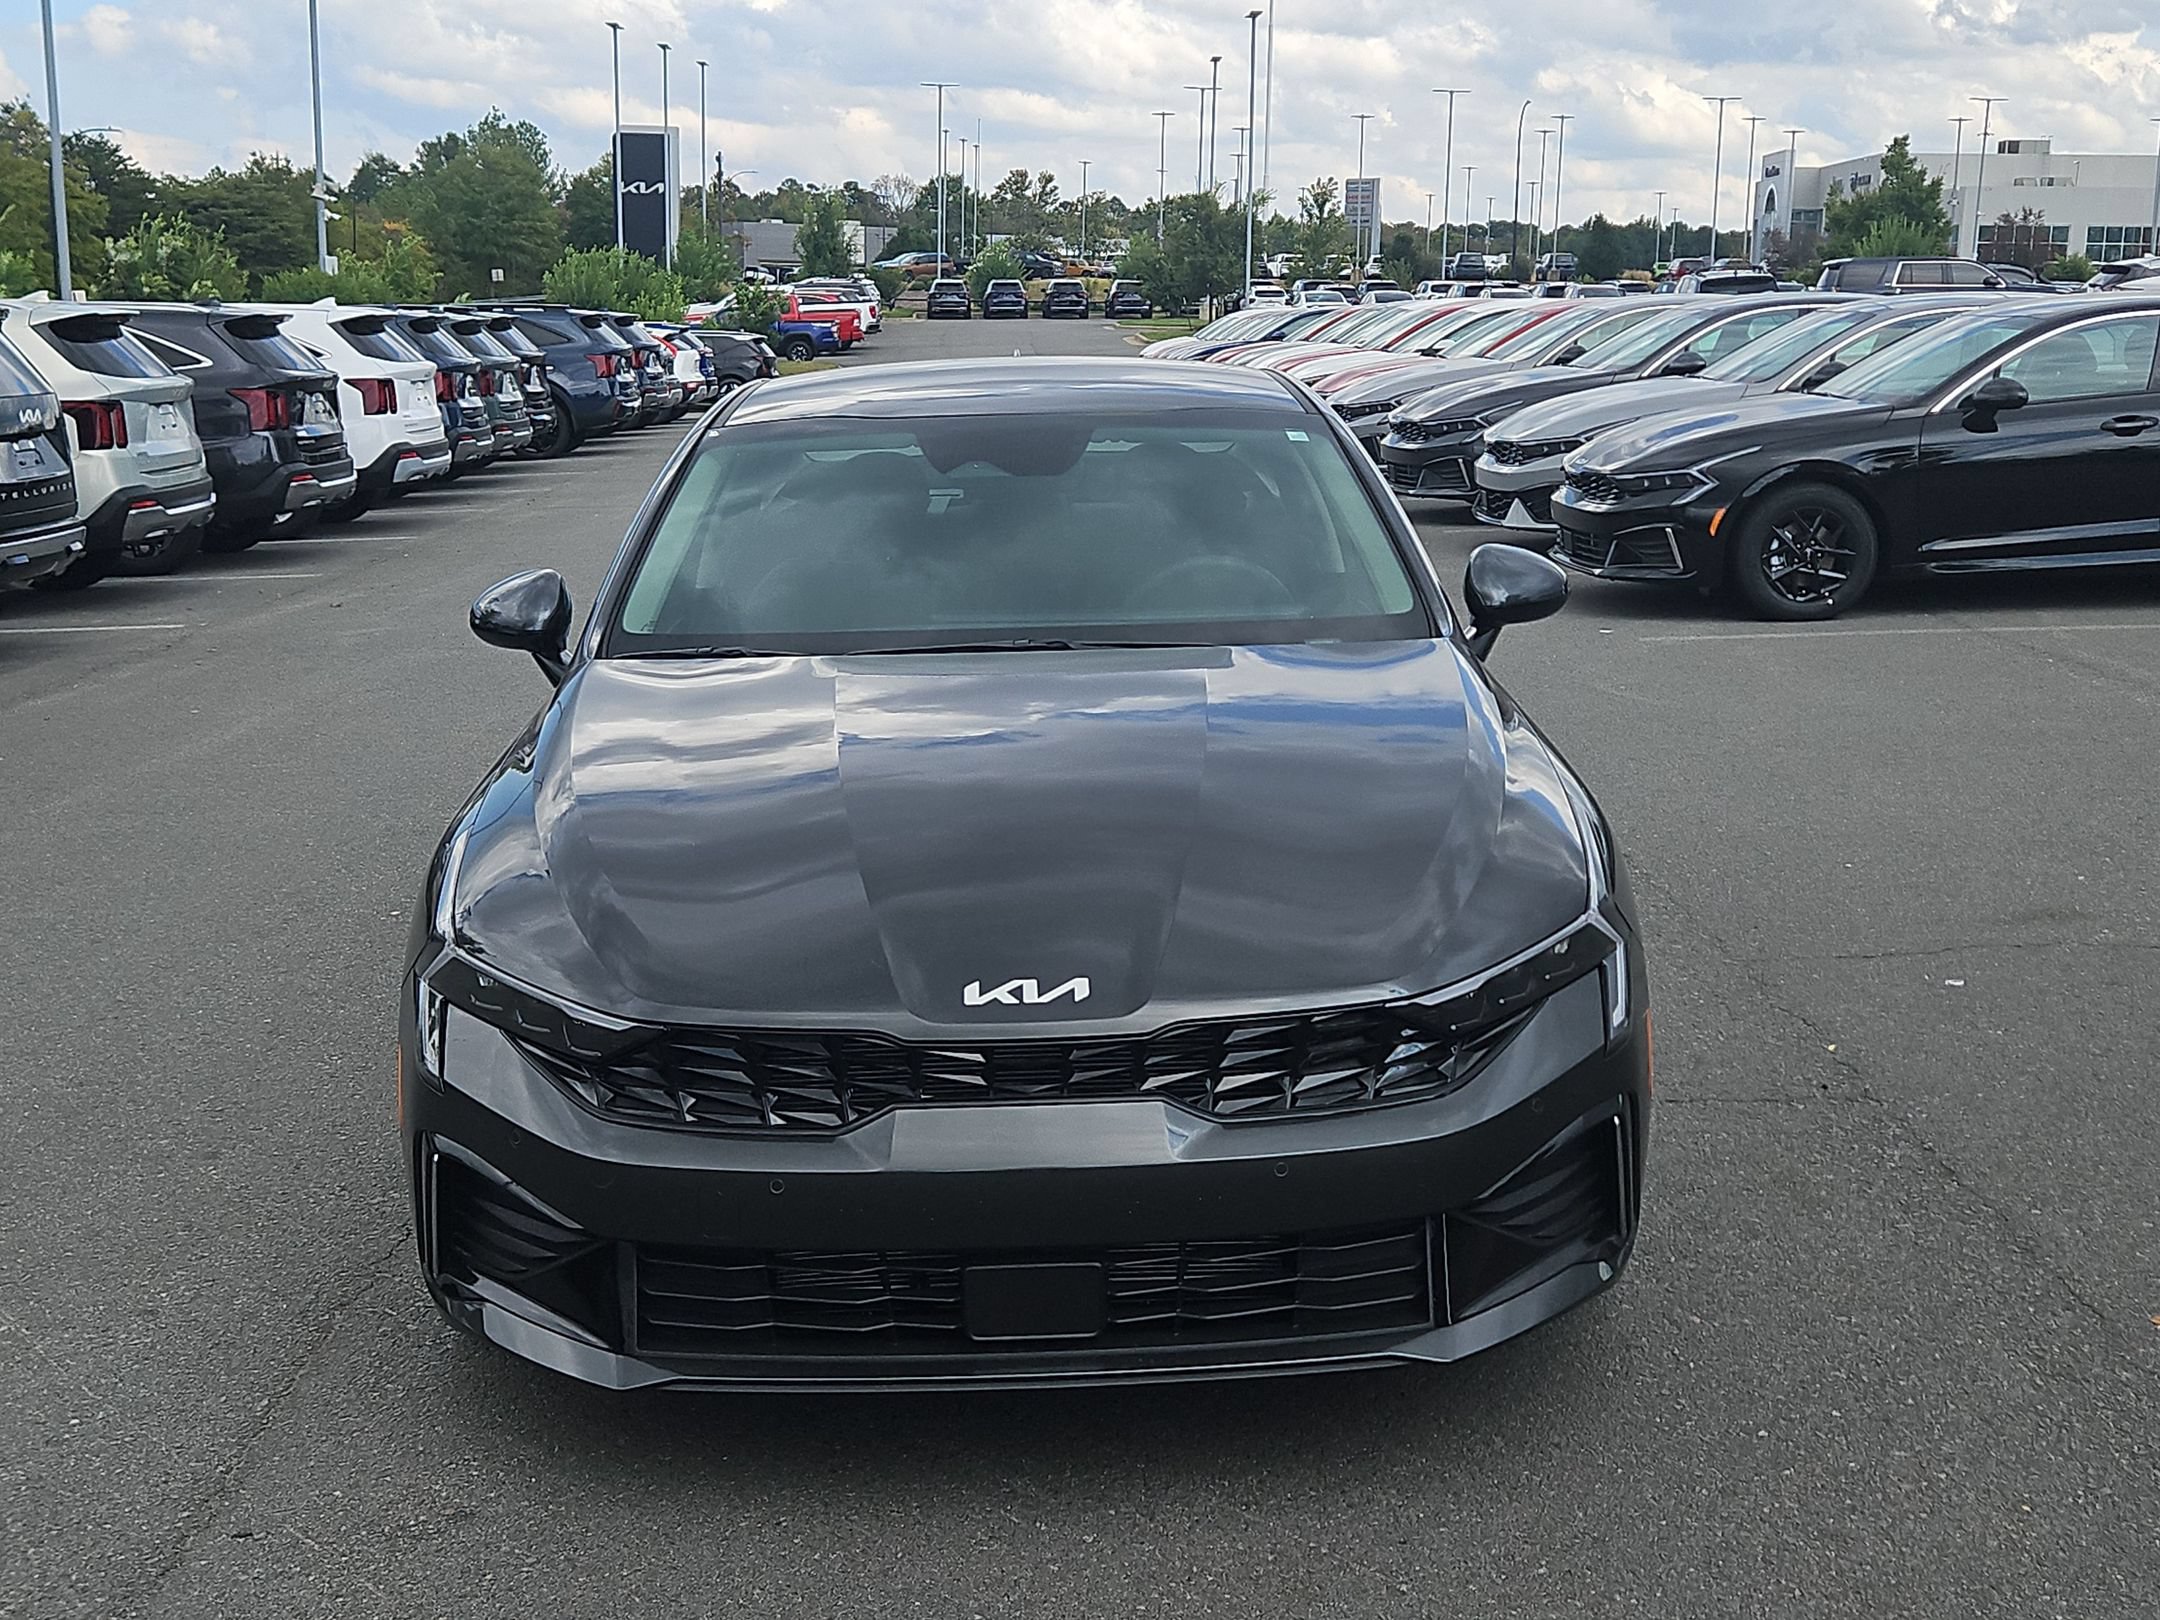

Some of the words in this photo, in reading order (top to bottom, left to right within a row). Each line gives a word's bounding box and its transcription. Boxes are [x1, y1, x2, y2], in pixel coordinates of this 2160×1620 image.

[620, 181, 665, 194] KIA
[18, 408, 42, 424] KIA
[963, 977, 1090, 1006] KIA
